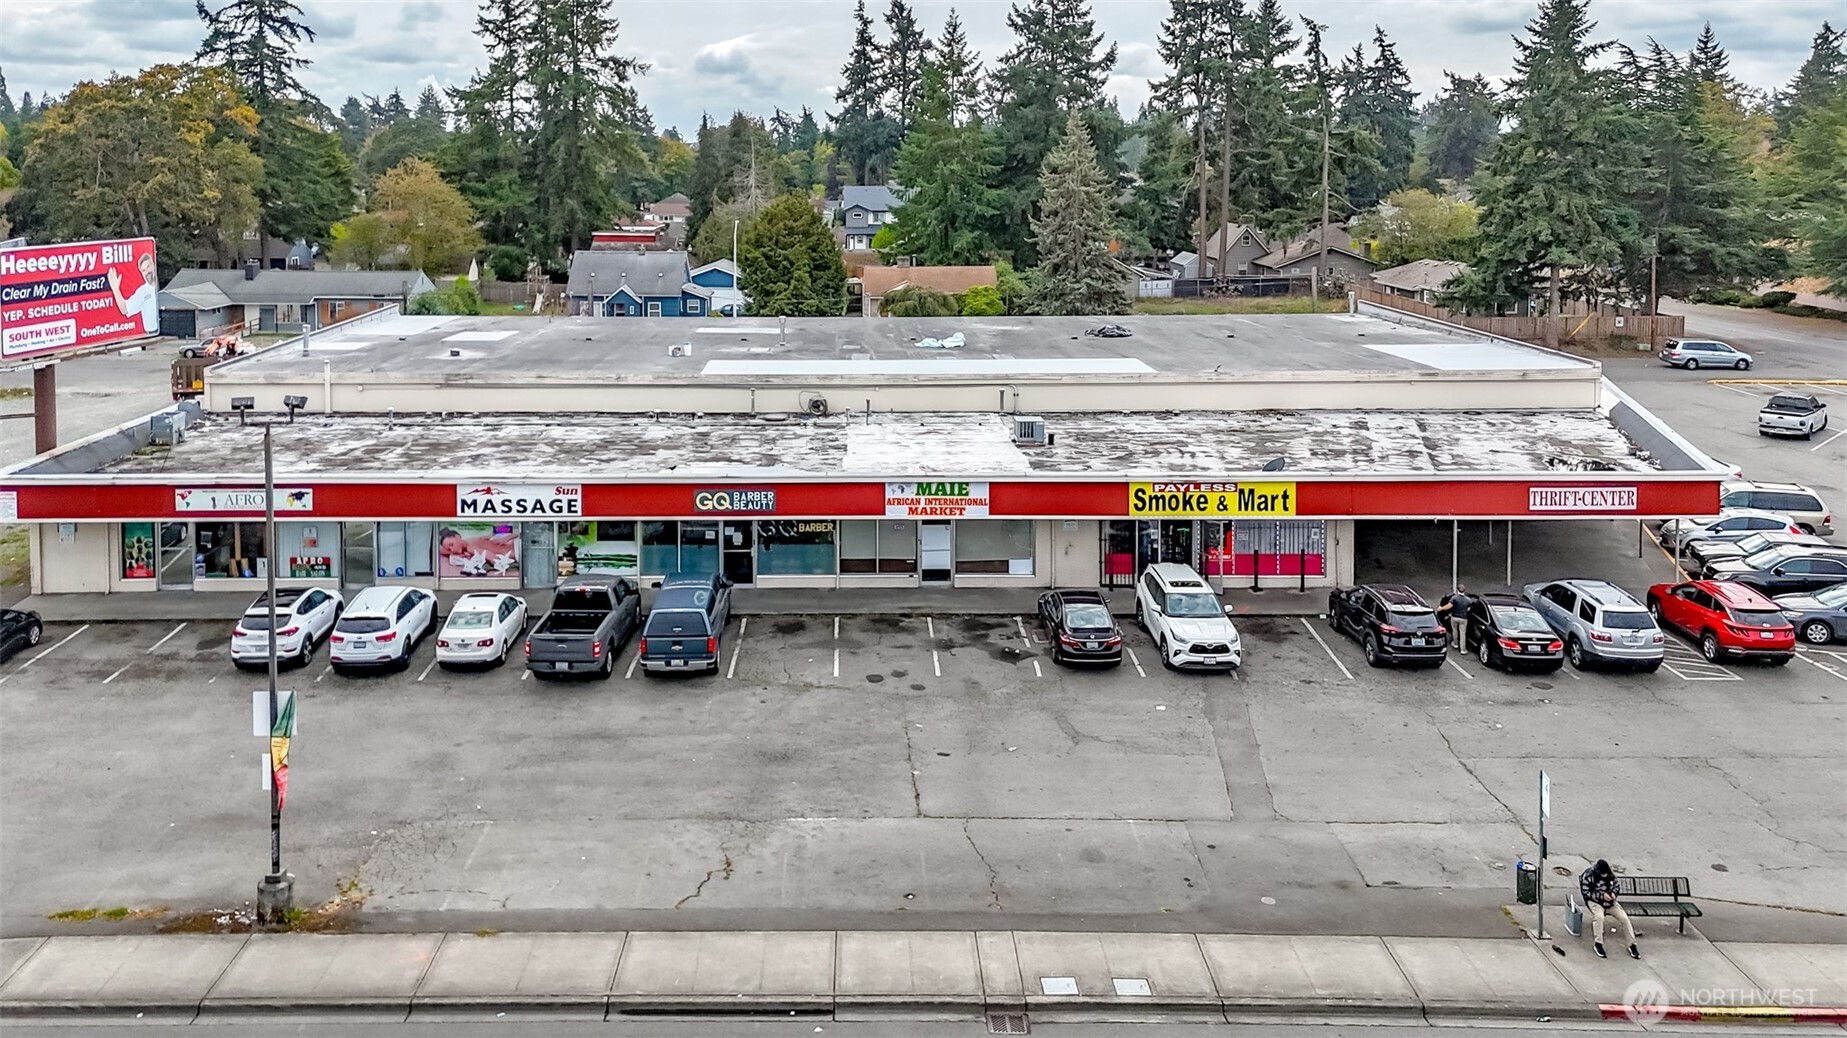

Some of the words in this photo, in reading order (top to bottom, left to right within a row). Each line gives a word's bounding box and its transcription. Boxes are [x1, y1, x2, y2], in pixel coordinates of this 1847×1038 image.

[1, 252, 97, 275] Heeeeyyyy
[102, 244, 133, 265] Bill!
[2, 287, 31, 301] Clear
[33, 284, 49, 299] My
[51, 280, 78, 293] Drain
[80, 277, 105, 291] Fast?
[3, 309, 25, 322] YEP.
[28, 302, 79, 317] SCHEDULE
[81, 297, 113, 311] TODAY!
[9, 330, 42, 343] SOUTH
[44, 325, 71, 337] WEST
[80, 322, 136, 338] OneToCall.com
[554, 486, 578, 495] Sun
[915, 482, 969, 496] MAIE
[1153, 484, 1237, 492] PAYLESS
[225, 493, 264, 506] AFRO
[696, 492, 732, 510] GQ
[733, 492, 774, 500] BARBER
[887, 498, 921, 506] AFRICAN
[924, 498, 988, 506] INTERNATIONAL
[1133, 487, 1209, 512] Smoke
[1216, 495, 1229, 512] &
[1238, 488, 1289, 512] Mart
[1531, 490, 1635, 507] THRIFT-CENTER
[460, 498, 578, 514] MASSAGE
[733, 501, 774, 510] BEAUTY
[908, 507, 966, 516] MARKET
[798, 523, 834, 533] BARBER
